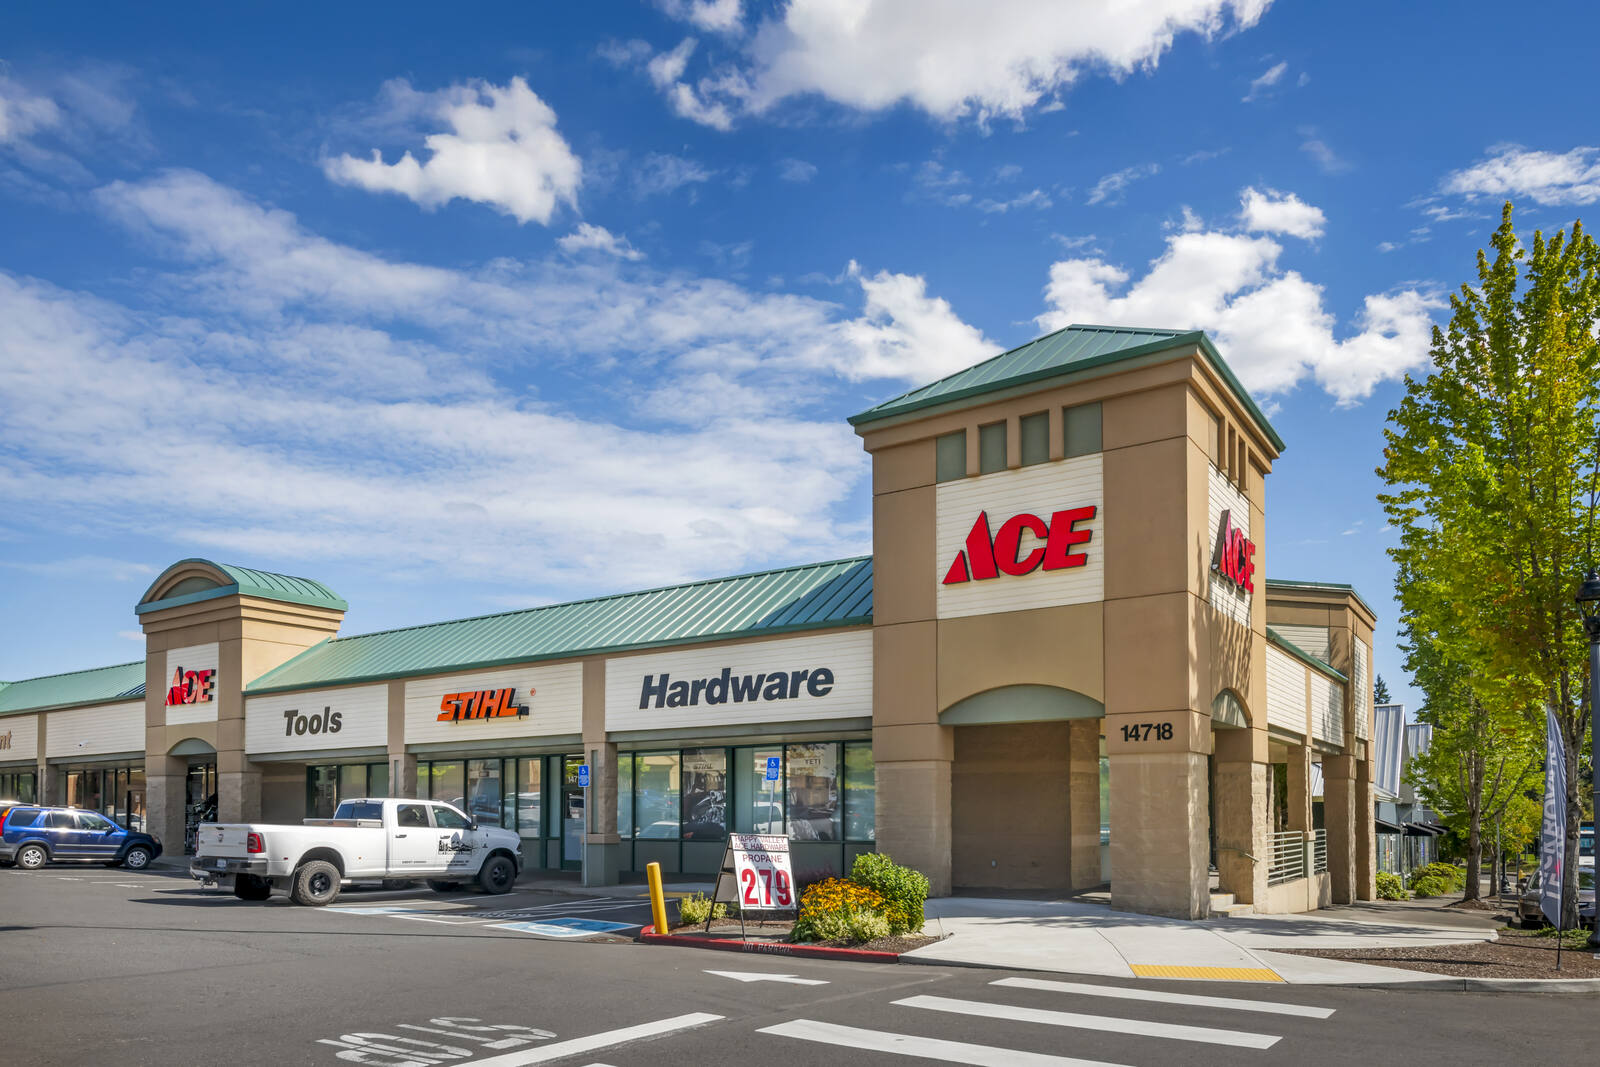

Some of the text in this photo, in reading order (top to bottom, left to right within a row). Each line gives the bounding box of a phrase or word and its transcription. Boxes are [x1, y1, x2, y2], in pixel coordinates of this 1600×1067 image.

[942, 505, 1098, 585] ACE
[1211, 509, 1256, 594] ACE
[165, 665, 216, 706] ACE
[639, 667, 835, 710] Hardware
[284, 706, 343, 737] Tools
[437, 687, 519, 722] STIHL
[1120, 722, 1174, 743] 14718
[734, 835, 785, 844] HAPPY VALLEY
[734, 842, 788, 851] ACE HARDWARE
[742, 853, 784, 864] PROPANE
[741, 868, 792, 906] 279
